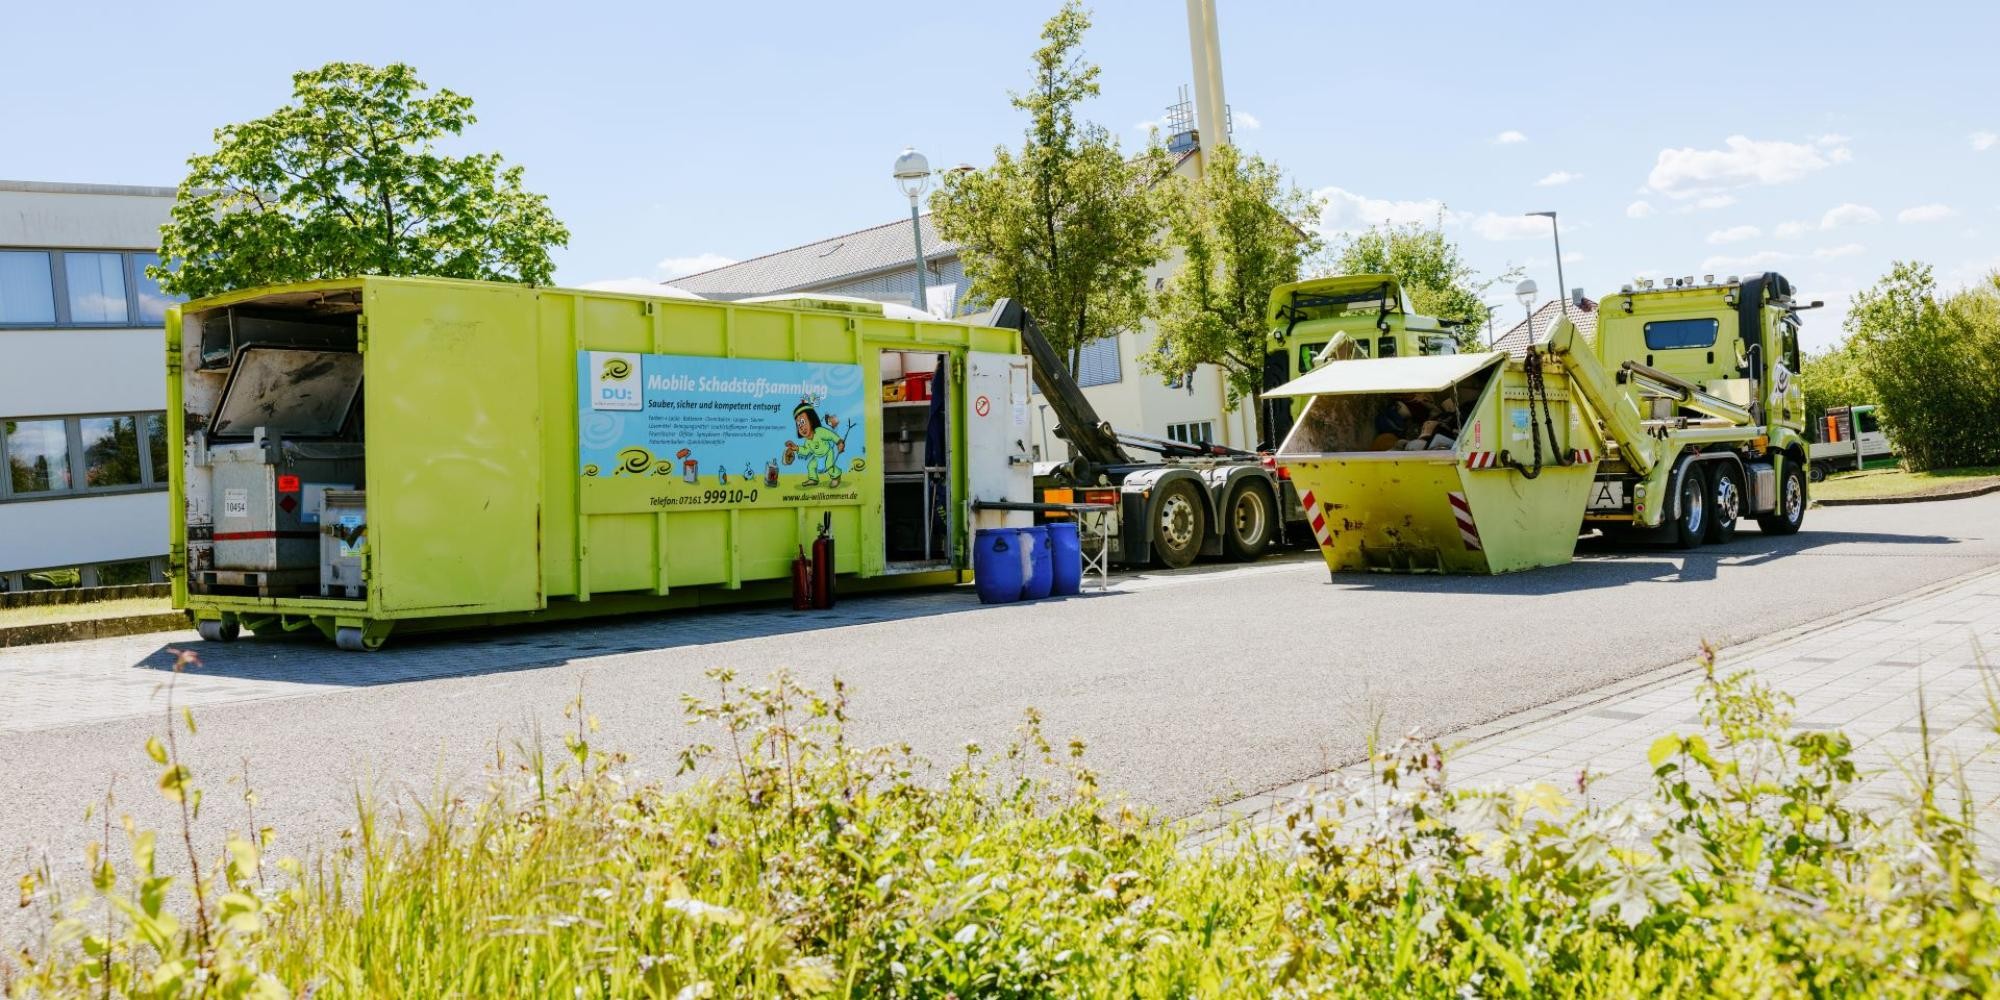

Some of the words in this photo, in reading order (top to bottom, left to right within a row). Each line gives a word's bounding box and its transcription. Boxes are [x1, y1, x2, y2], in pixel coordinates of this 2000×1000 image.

[648, 374, 696, 392] Mobile
[698, 376, 828, 399] Schadstoffsammlung
[602, 387, 632, 400] DU:
[648, 400, 676, 411] Sauber,
[676, 401, 698, 409] sicher
[699, 402, 713, 410] und
[714, 401, 752, 412] kompetent
[753, 403, 781, 413] entsorgt
[1596, 485, 1615, 505] A
[226, 502, 246, 512] 10454
[650, 496, 678, 508] Telefon:
[679, 496, 702, 505] 07161
